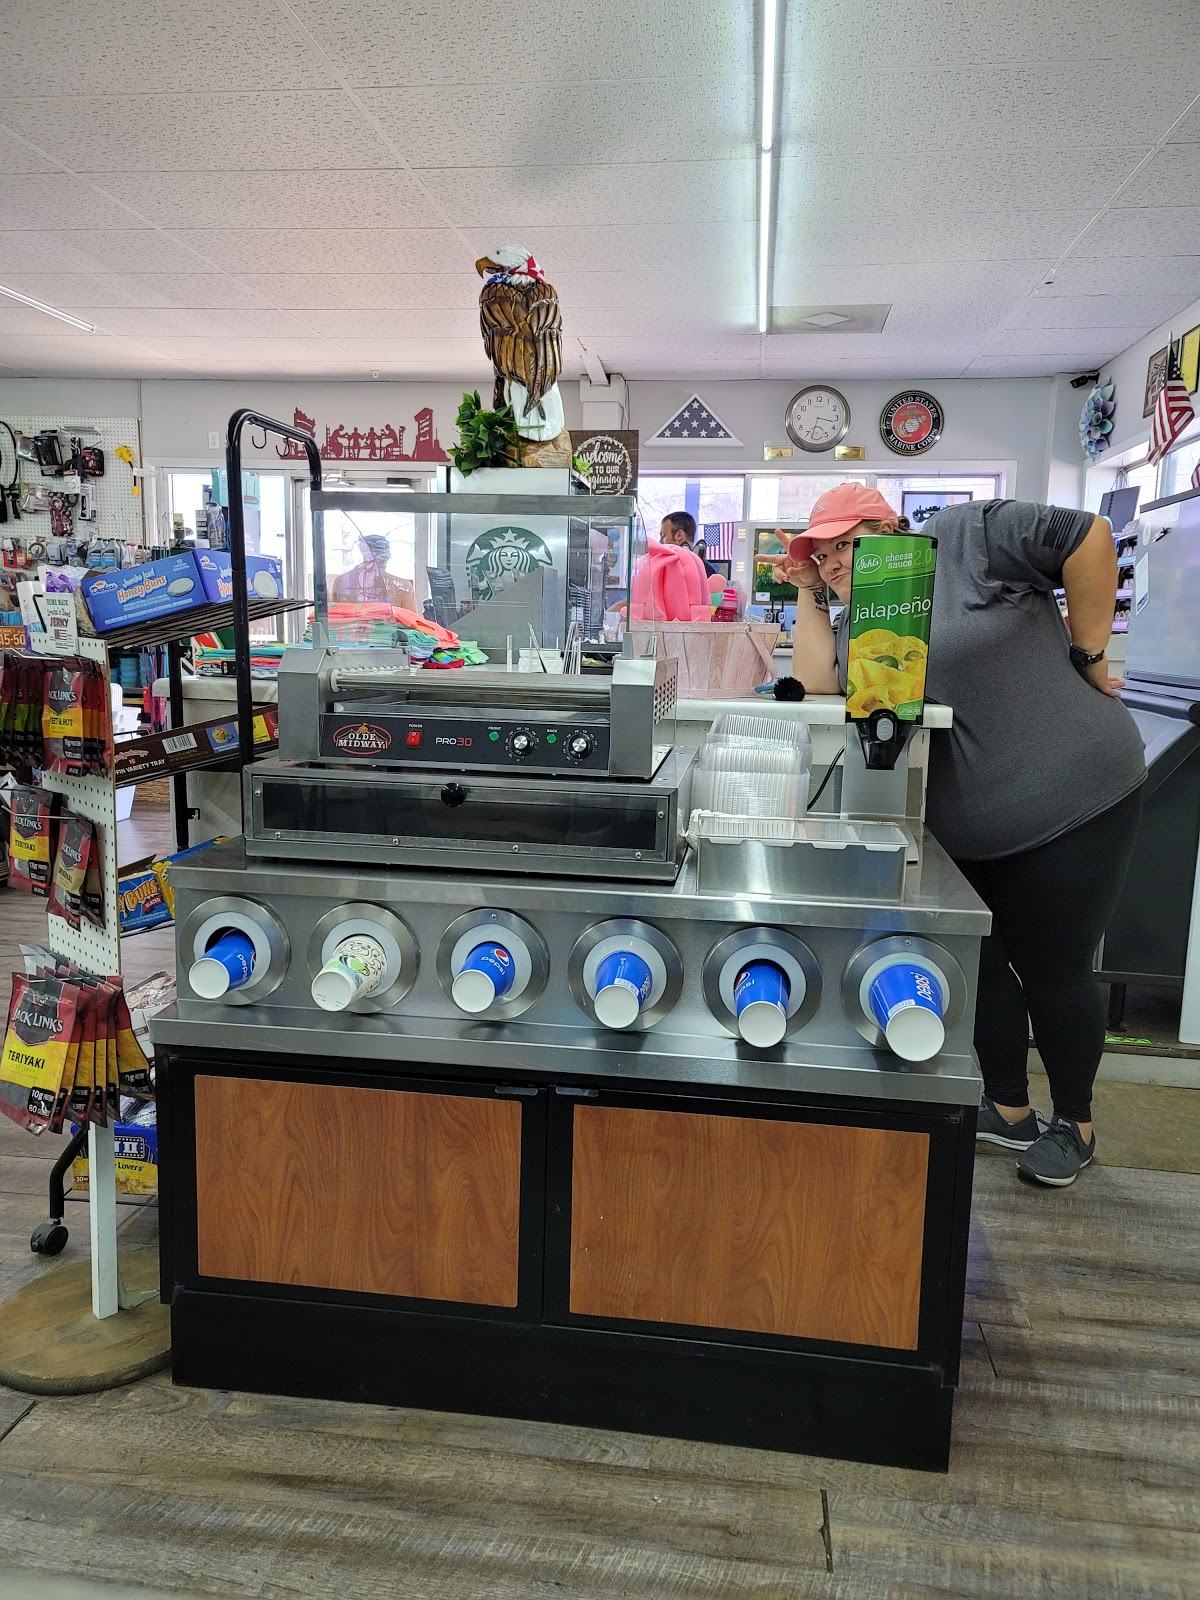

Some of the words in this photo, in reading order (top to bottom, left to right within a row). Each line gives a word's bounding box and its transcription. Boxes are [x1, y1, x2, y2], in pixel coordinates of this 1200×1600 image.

[888, 396, 914, 417] UNITED
[914, 396, 938, 418] STATES
[890, 434, 916, 450] MARINE
[918, 428, 938, 448] CORPS
[580, 442, 624, 465] welcome
[590, 474, 622, 490] ginning
[886, 552, 912, 562] cheese
[914, 548, 932, 566] 2.0
[888, 560, 912, 569] sauce
[122, 574, 142, 588] Jumbo
[142, 568, 156, 578] Iced
[90, 583, 116, 594] Duchess
[118, 584, 144, 602] Honey
[144, 576, 166, 591] Buns
[853, 596, 932, 623] jalapeño
[50, 617, 68, 628] JERKY
[63, 718, 73, 726] HOT
[338, 740, 384, 749] MIDWAY
[348, 732, 376, 740] OLDE
[126, 763, 150, 772] VARIETY
[150, 758, 165, 767] TRAY
[15, 840, 36, 851] TERIYAKI
[126, 879, 158, 910] BUNS
[481, 956, 506, 976] pepsi
[910, 972, 936, 1006] pepsi
[12, 1008, 32, 1026] JACK
[8, 1050, 45, 1070] TERIYAKI
[31, 1089, 43, 1100] 10g
[28, 1104, 37, 1114] 80
[118, 1162, 142, 1172] Lovers
